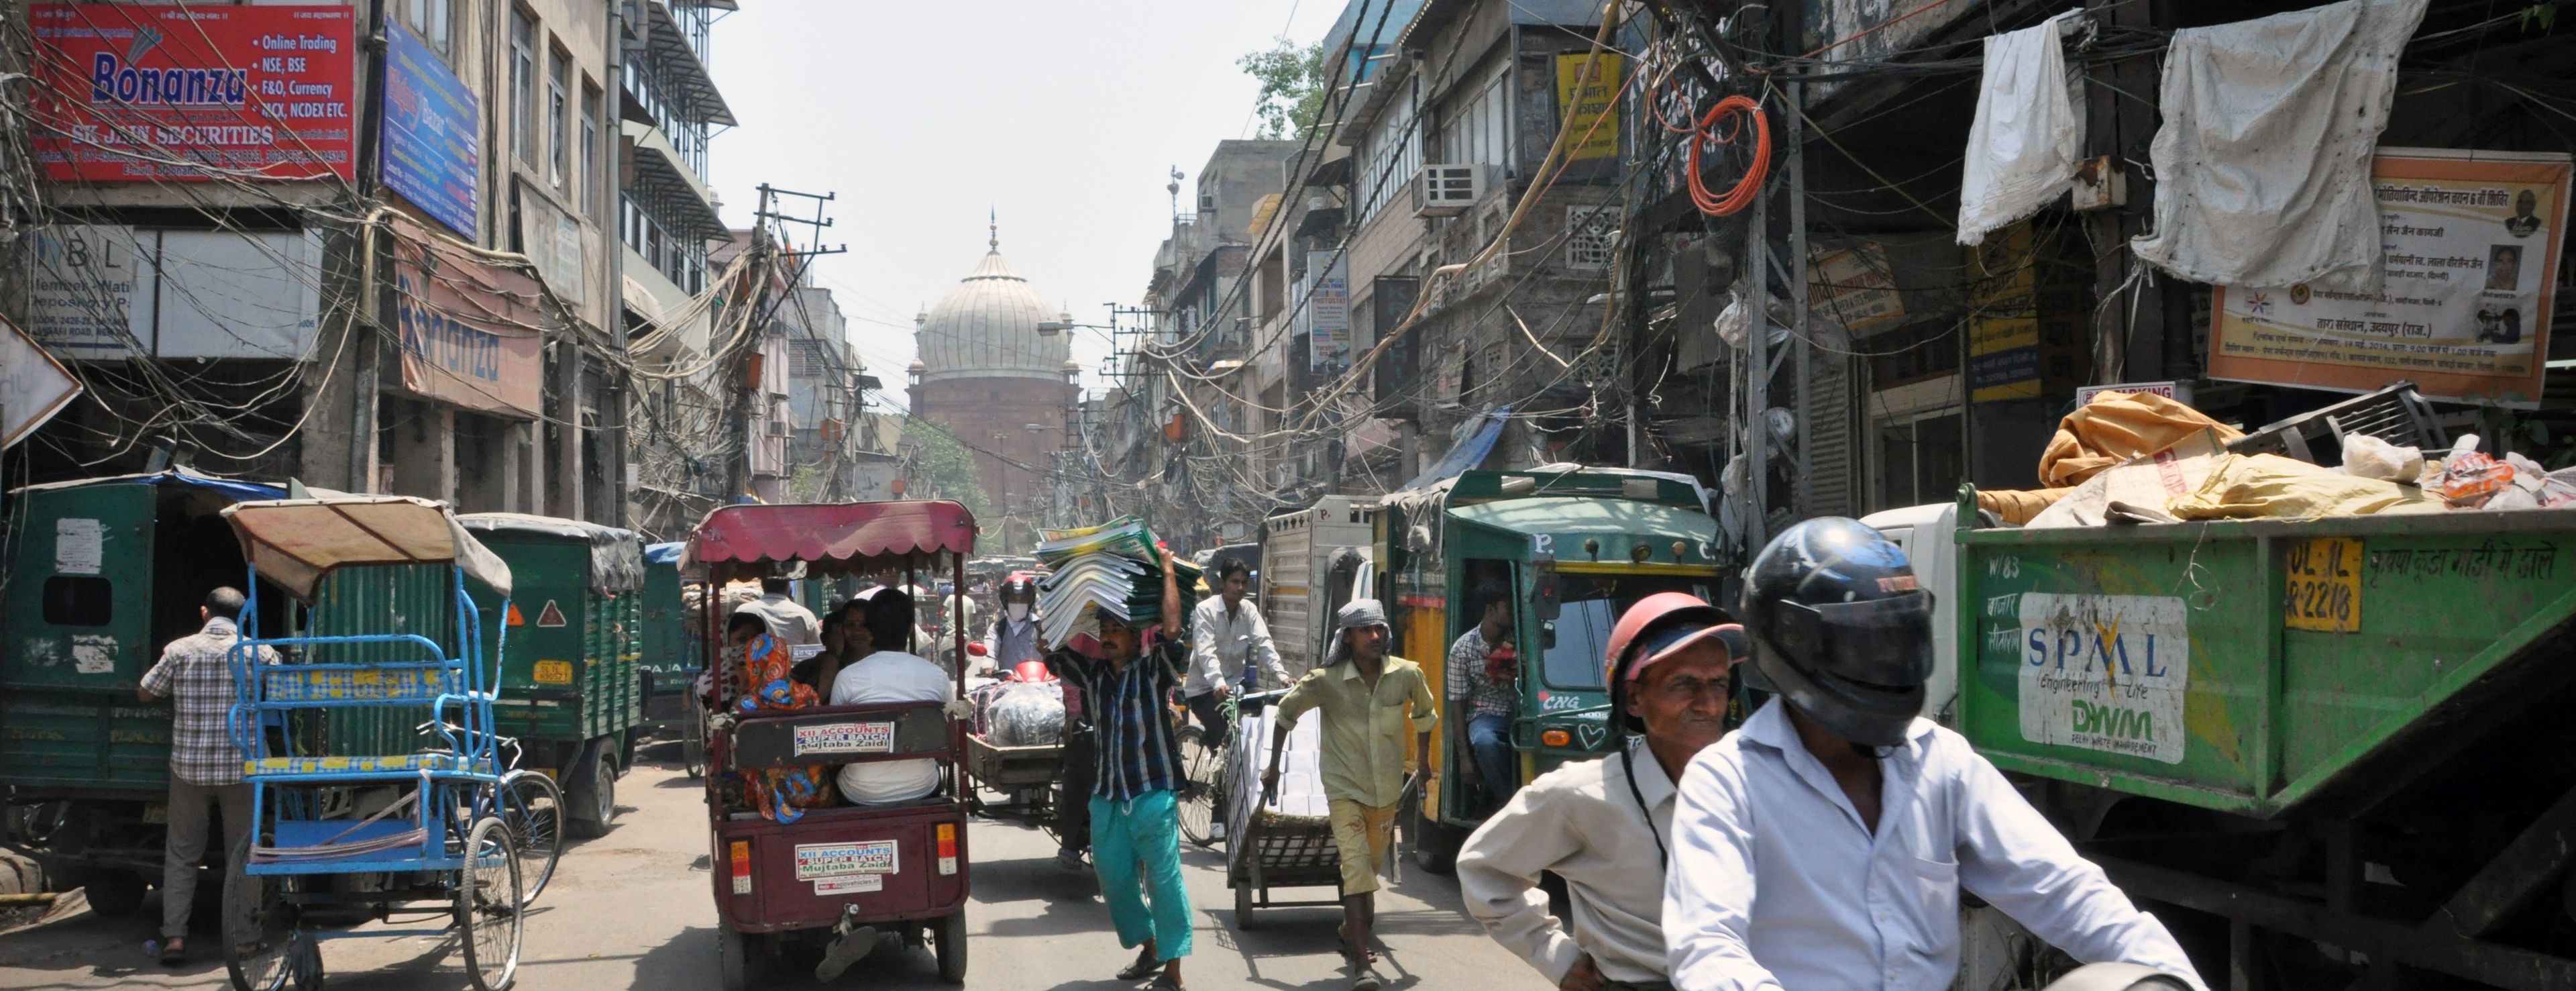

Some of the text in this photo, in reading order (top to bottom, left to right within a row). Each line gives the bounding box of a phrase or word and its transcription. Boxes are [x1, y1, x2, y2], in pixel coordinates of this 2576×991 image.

[262, 35, 336, 54] Online Trading
[262, 58, 306, 74] NSE, BSE
[93, 51, 248, 105] Bonanza
[262, 80, 333, 98] F&O, Currency
[290, 103, 325, 117] NCDEX
[327, 103, 347, 117] ETC.
[72, 125, 99, 144] SK
[156, 125, 273, 145] SECURITIES
[1532, 533, 1555, 554] P.
[1988, 556, 2020, 579] W/83
[2029, 627, 2168, 678] SPML
[2126, 683, 2148, 699] Life
[1543, 695, 1580, 710] CNG
[2072, 698, 2154, 741] DWM
[805, 735, 845, 743] SUPER
[820, 727, 888, 735] ACCOUNTS
[802, 741, 851, 749] Mujtaba
[807, 854, 891, 865] SUPER BATCH
[822, 847, 891, 857] ACCOUNTS
[802, 862, 855, 872] Mujtaba
